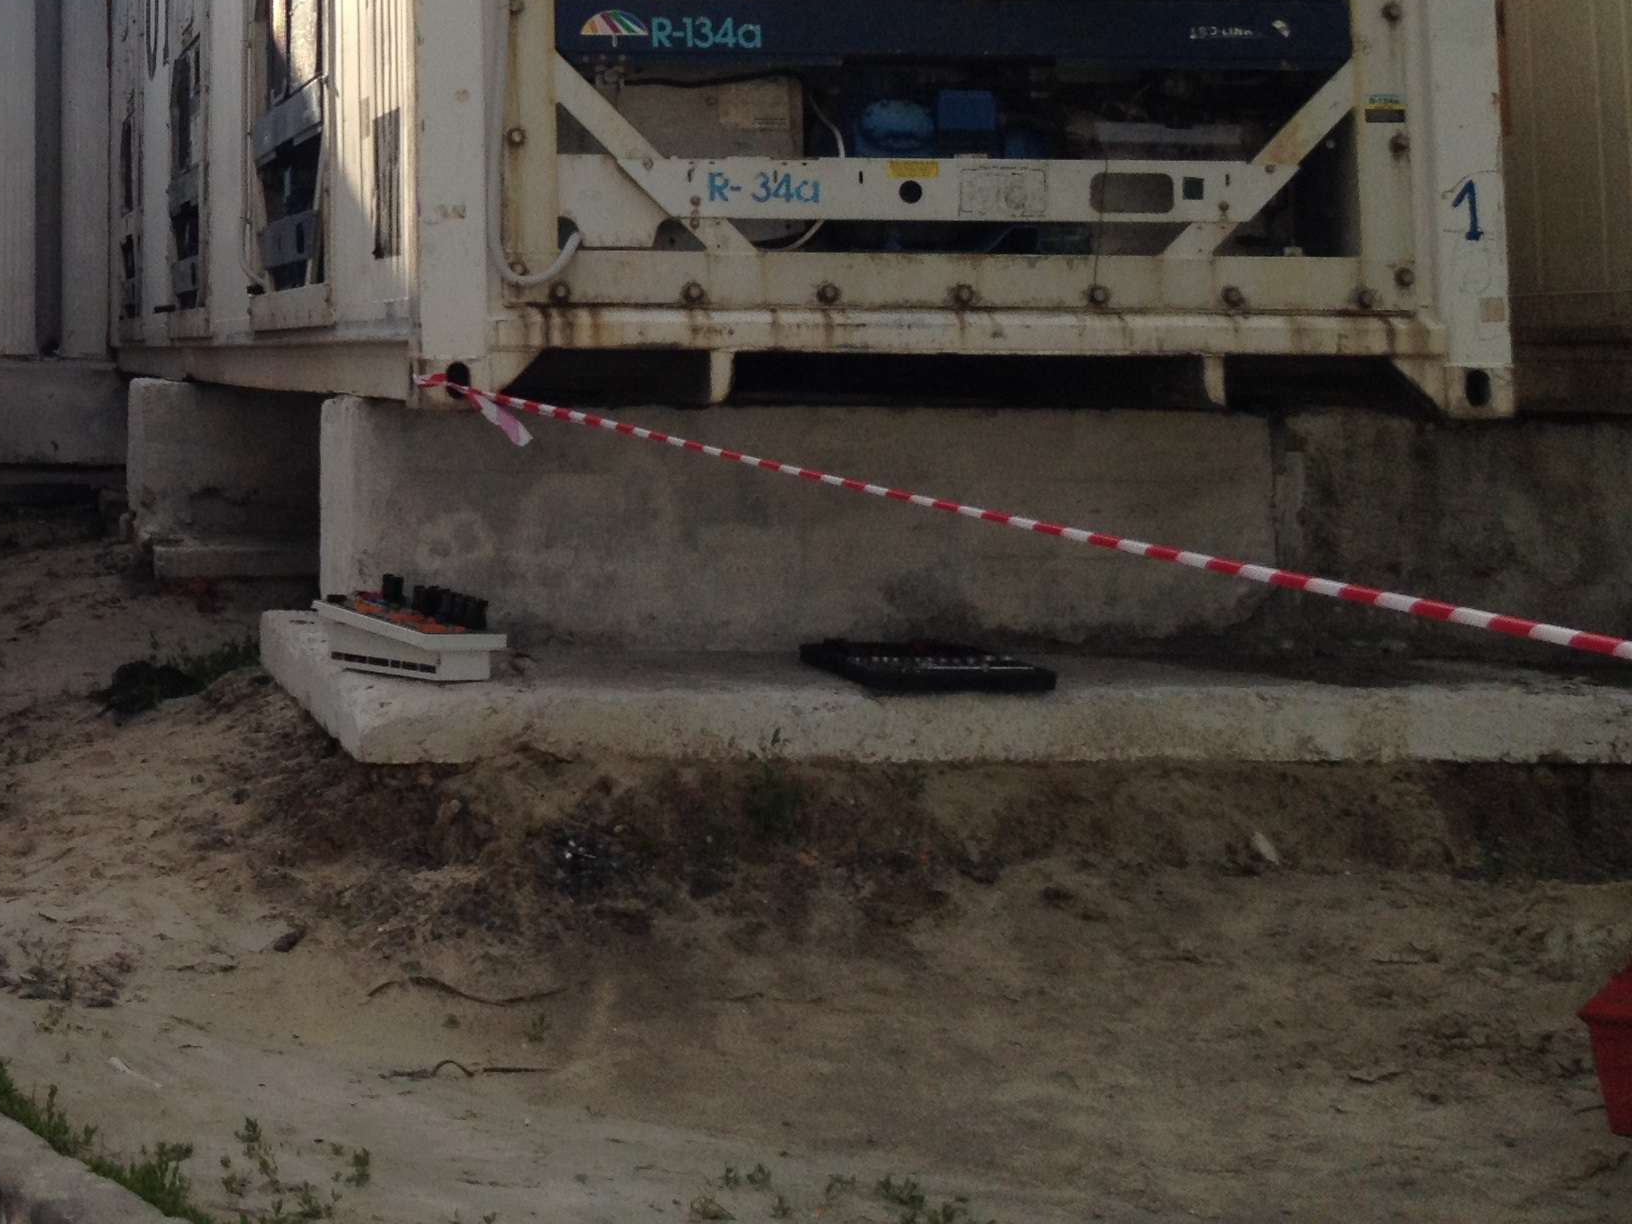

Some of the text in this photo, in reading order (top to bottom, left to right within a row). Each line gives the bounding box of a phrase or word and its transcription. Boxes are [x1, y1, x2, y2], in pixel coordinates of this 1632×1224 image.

[651, 15, 763, 49] R-134a
[707, 171, 821, 203] R-34a
[1452, 179, 1484, 241] 1
